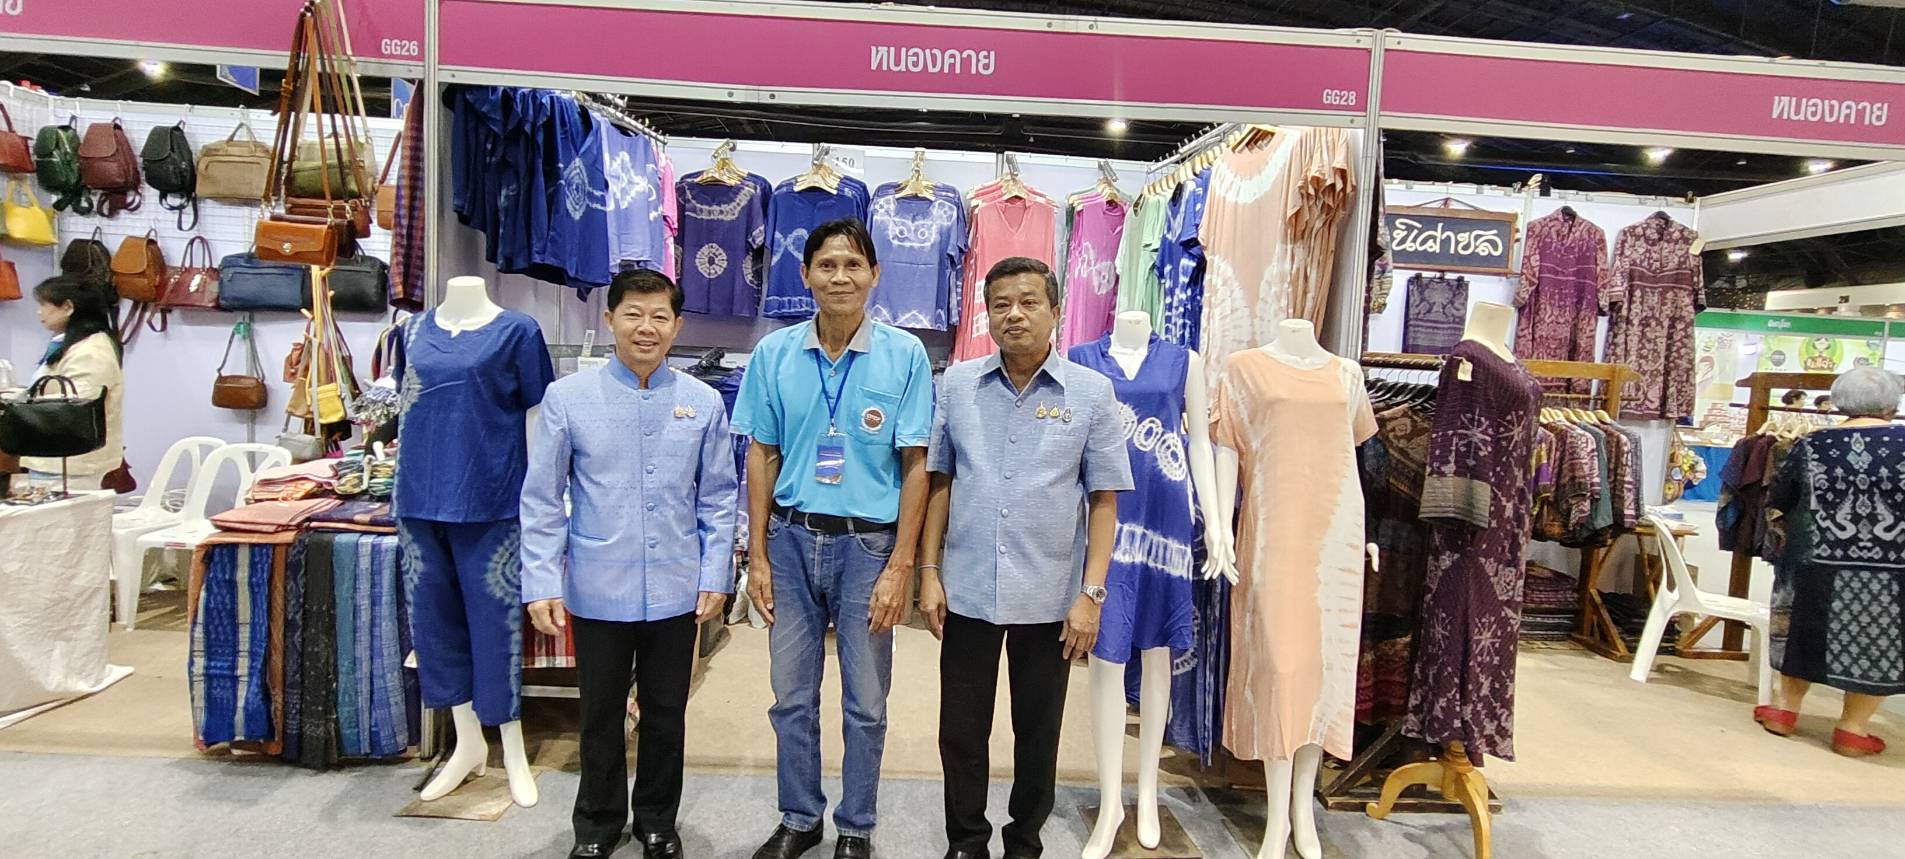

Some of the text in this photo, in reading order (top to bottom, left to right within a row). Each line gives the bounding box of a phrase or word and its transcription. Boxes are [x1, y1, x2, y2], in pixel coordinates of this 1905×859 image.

[381, 38, 419, 56] GG26
[870, 45, 995, 75] หนองคาย
[1322, 88, 1357, 106] GG28
[1771, 95, 1889, 126] หนองคาย
